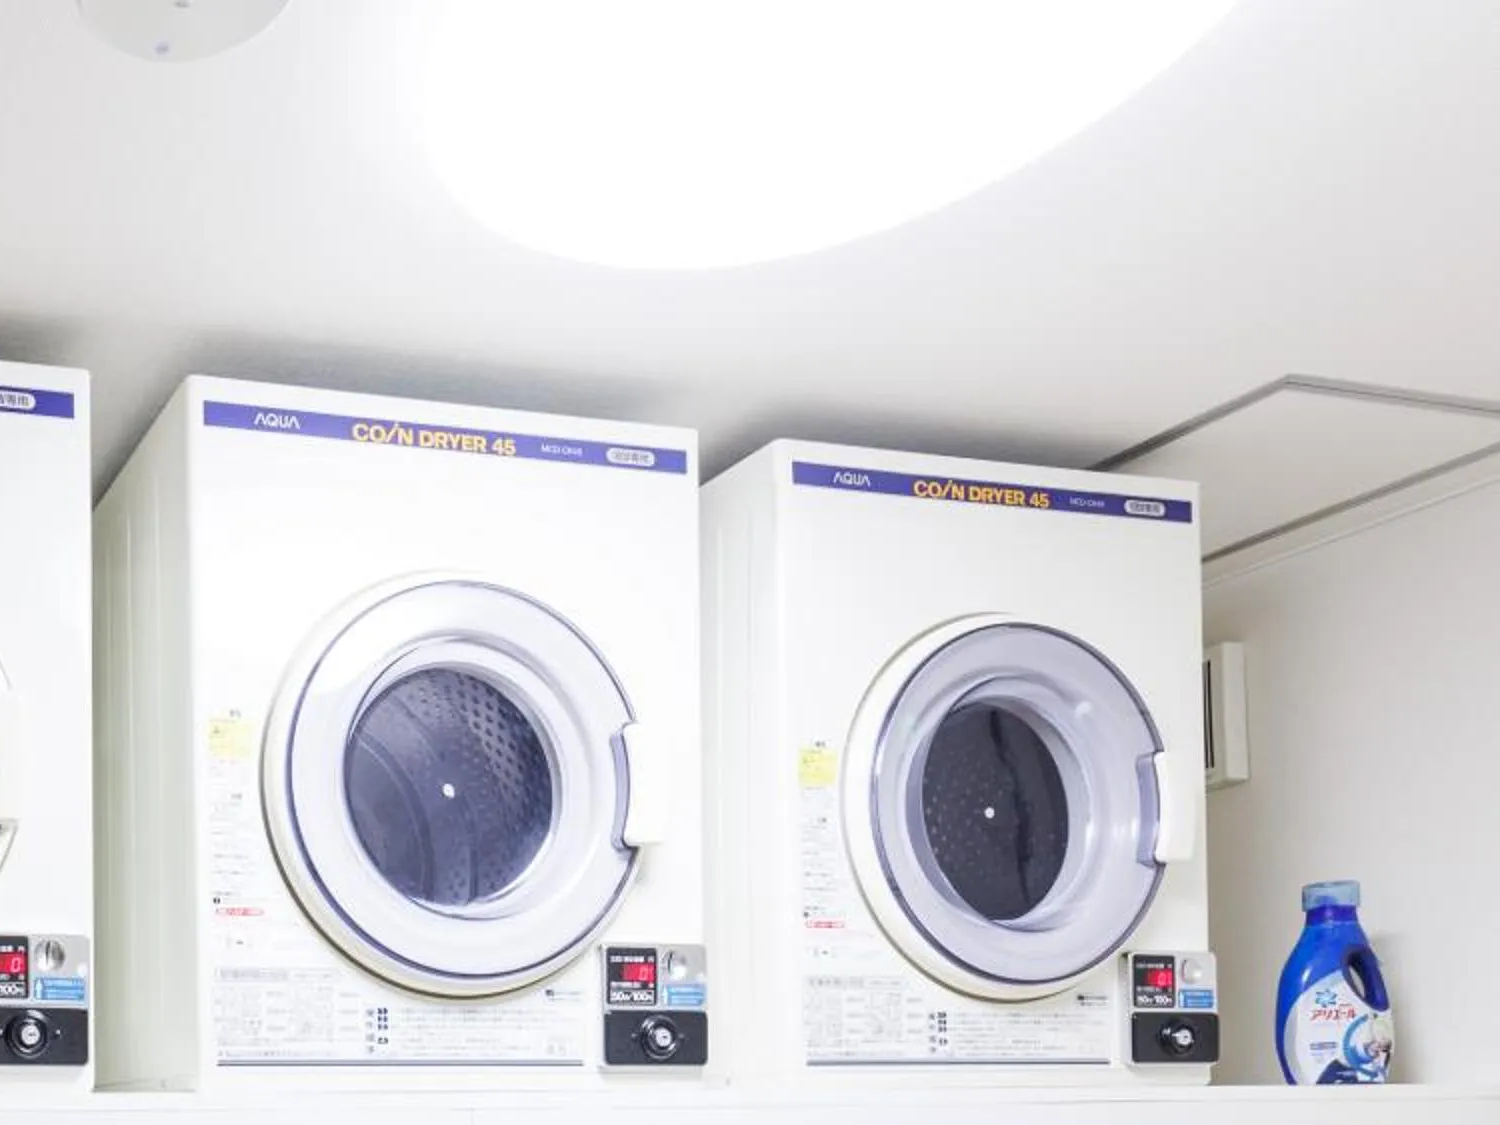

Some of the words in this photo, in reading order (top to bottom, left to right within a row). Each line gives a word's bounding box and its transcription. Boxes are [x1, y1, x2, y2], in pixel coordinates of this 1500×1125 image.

[254, 411, 301, 430] AQUA
[420, 431, 486, 453] DRYER
[492, 439, 516, 456] 45
[833, 471, 871, 487] AQUA
[969, 486, 1025, 506] DRYER
[1029, 491, 1050, 508] 45
[11, 956, 21, 973] 0
